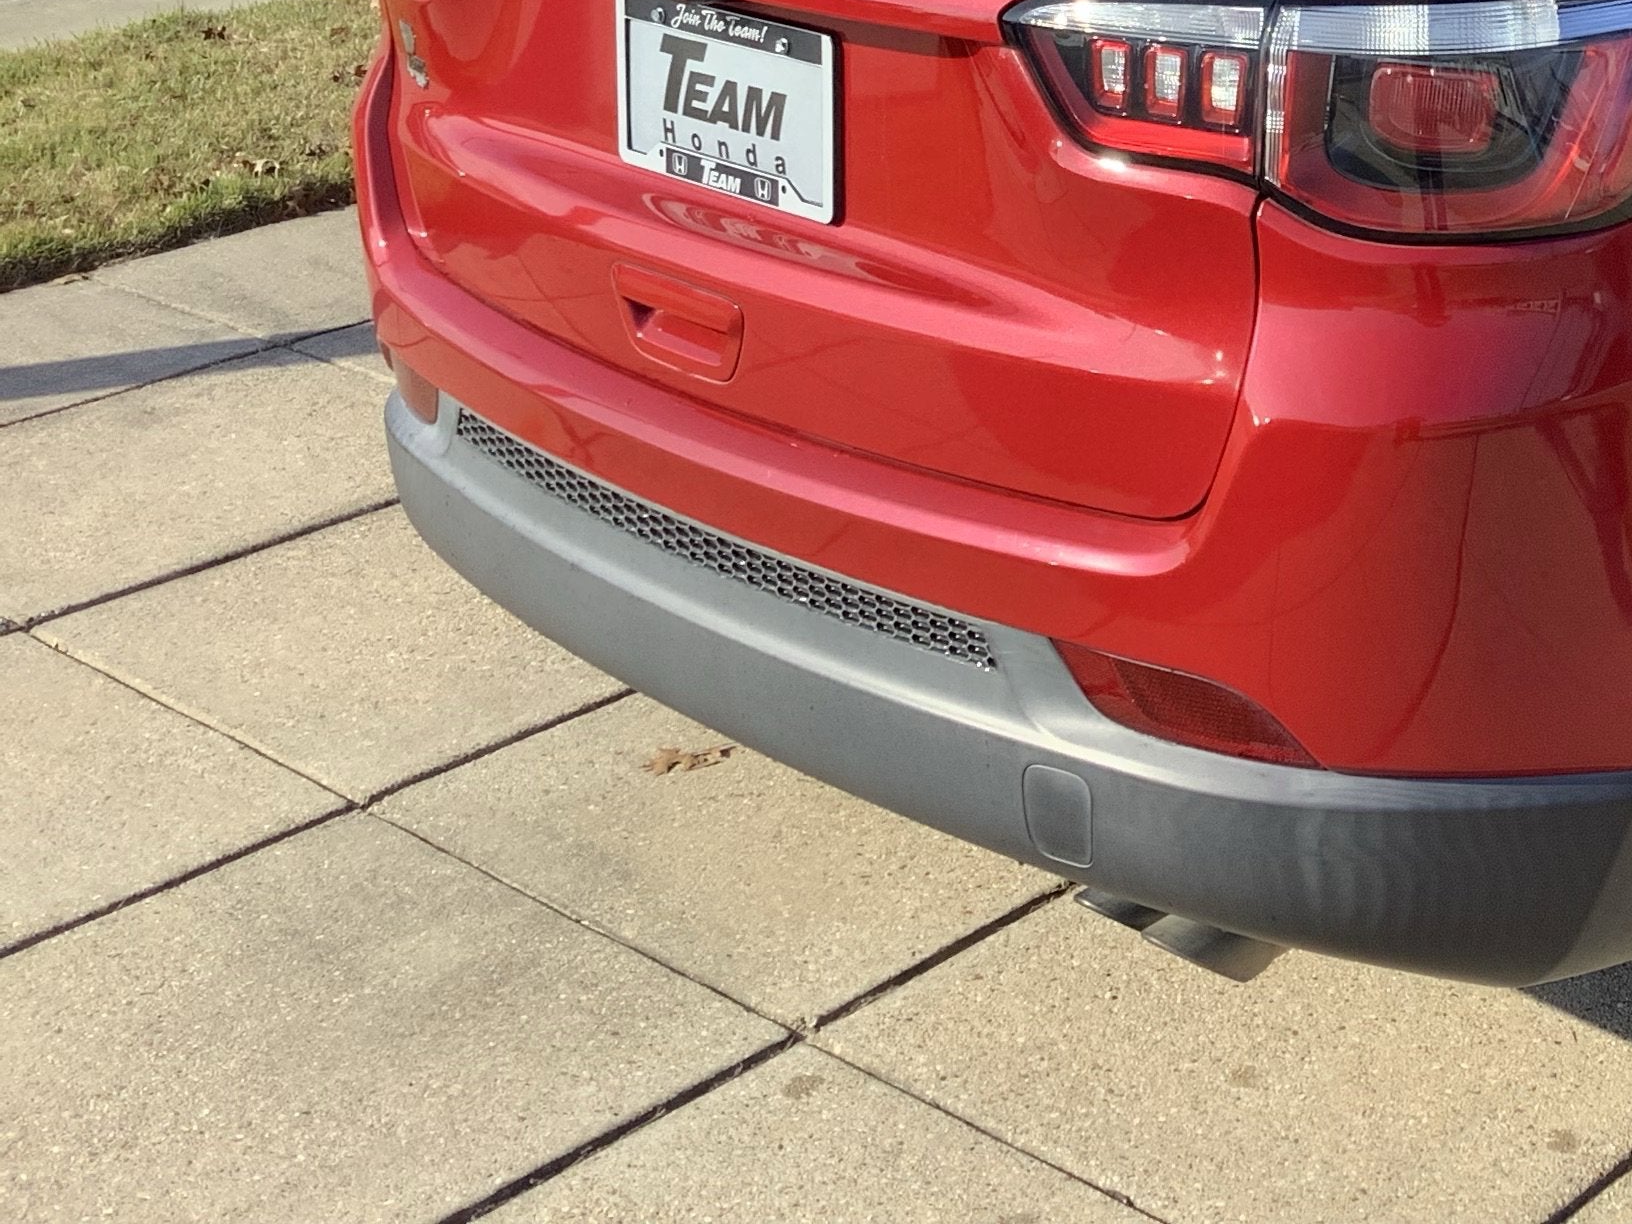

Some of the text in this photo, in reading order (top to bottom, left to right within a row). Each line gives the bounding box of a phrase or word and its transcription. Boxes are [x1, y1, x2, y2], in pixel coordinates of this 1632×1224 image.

[671, 3, 768, 44] Join The Team!
[658, 33, 788, 142] TEAM
[661, 117, 787, 176] Honda
[700, 159, 742, 195] TEAM
